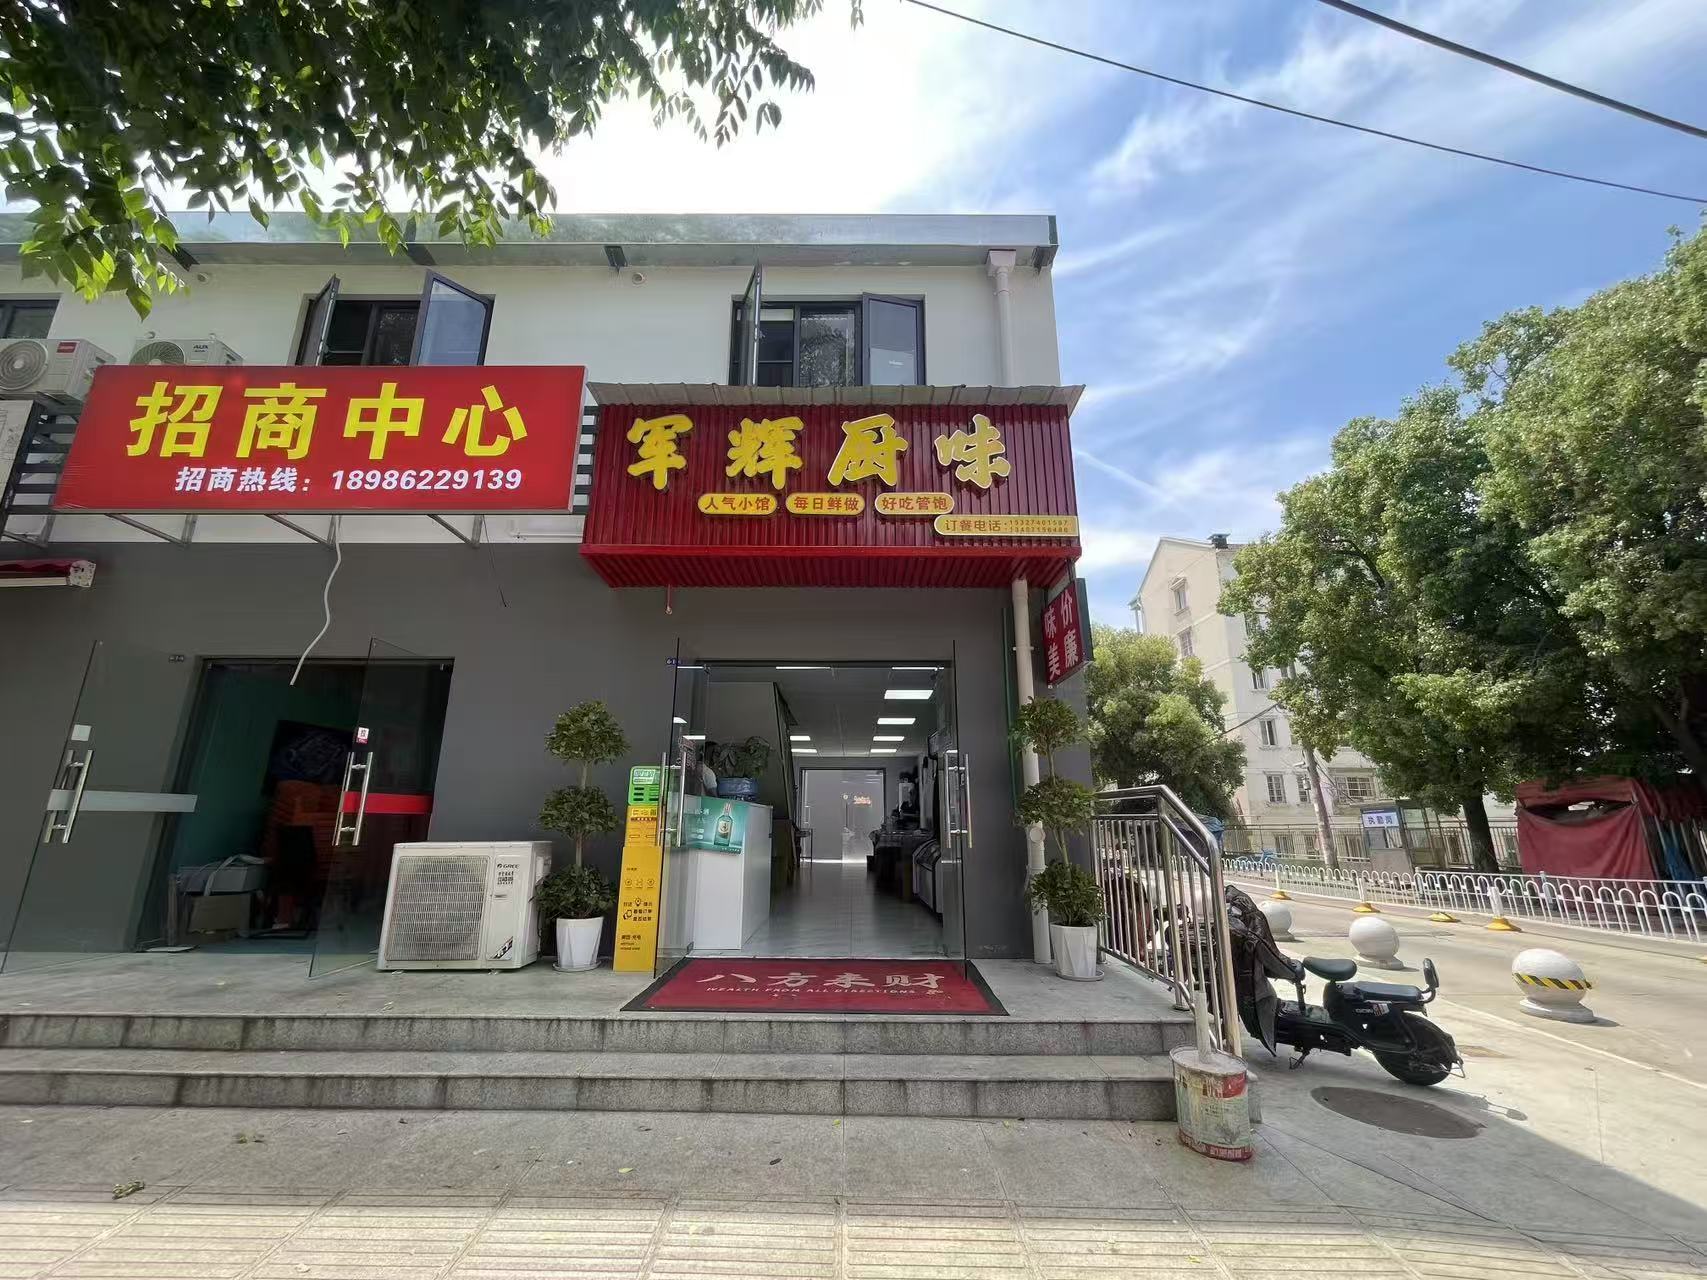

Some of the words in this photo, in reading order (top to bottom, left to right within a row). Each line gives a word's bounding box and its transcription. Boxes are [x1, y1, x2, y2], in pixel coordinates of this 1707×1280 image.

[127, 381, 528, 460] 招商中心
[626, 412, 1011, 491] 军辉厨味
[332, 468, 522, 491] 18986229139
[704, 496, 771, 511] 人气小馆
[793, 496, 860, 511] 每日鲜做
[881, 496, 948, 511] 好吃管饱
[1060, 588, 1079, 668] 价廉
[1044, 606, 1061, 681] 味美
[696, 972, 945, 990] 八方来财
